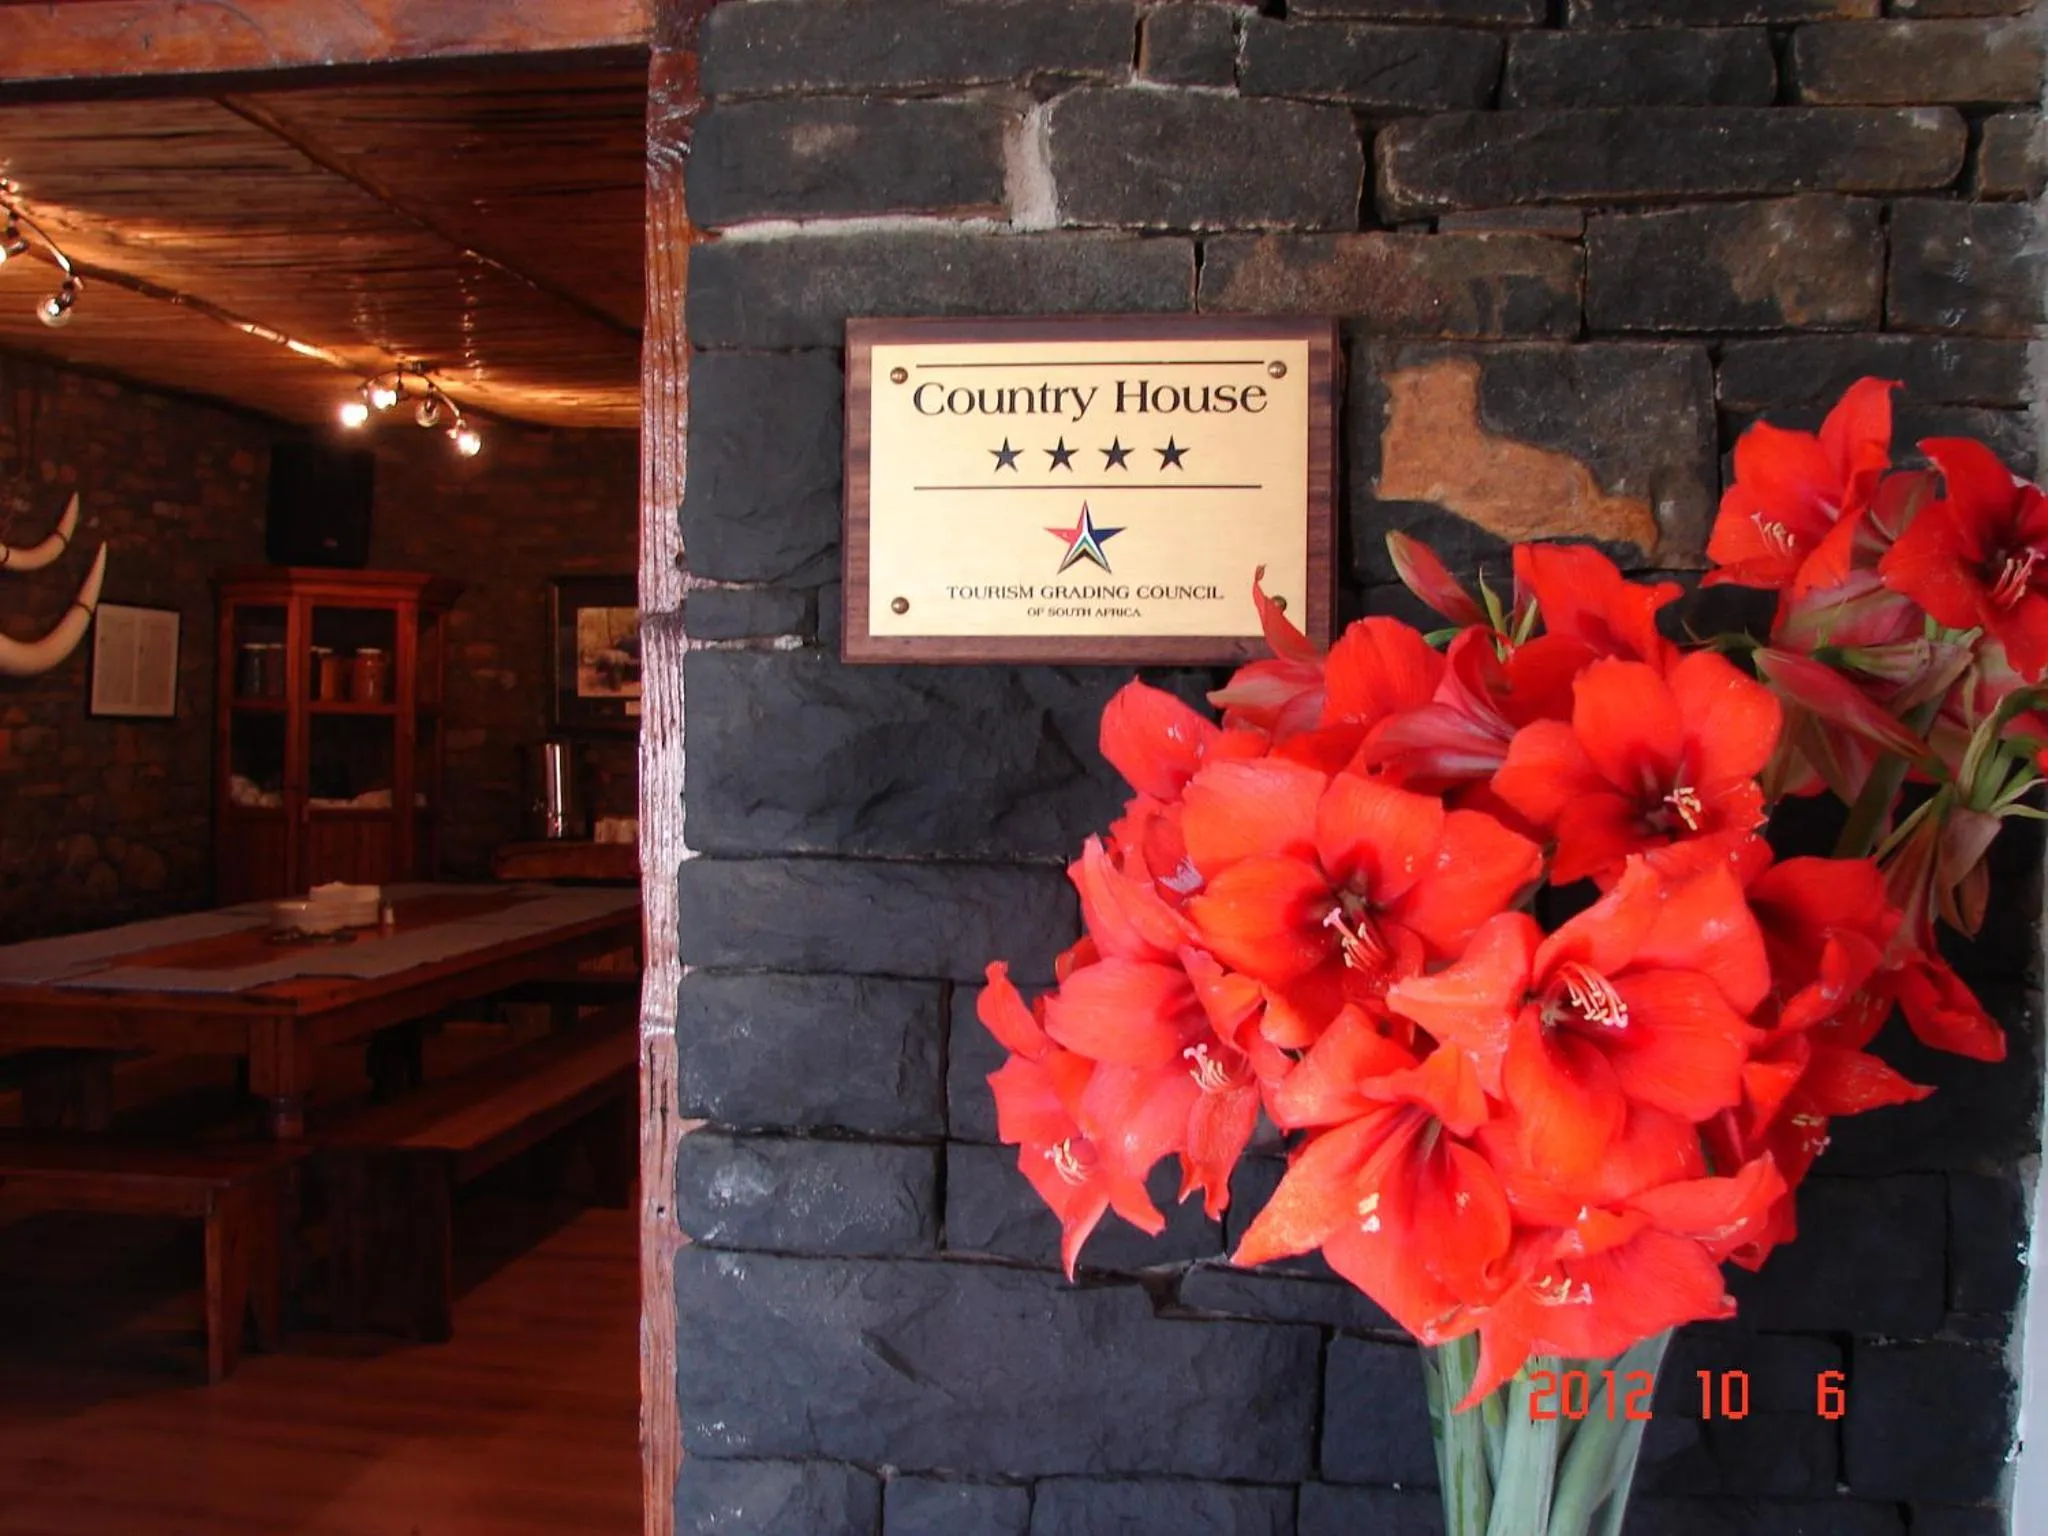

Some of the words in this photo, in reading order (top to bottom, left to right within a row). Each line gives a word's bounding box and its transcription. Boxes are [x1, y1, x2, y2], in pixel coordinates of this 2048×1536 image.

[913, 381, 1098, 422] Country
[1115, 379, 1268, 414] House
[946, 585, 1034, 600] TOURISM
[1040, 585, 1130, 600] GRADING
[1136, 585, 1225, 600] COUNCIL
[1027, 607, 1045, 618] OF
[1048, 607, 1092, 618] SOUTH
[1095, 607, 1142, 618] AFRICA
